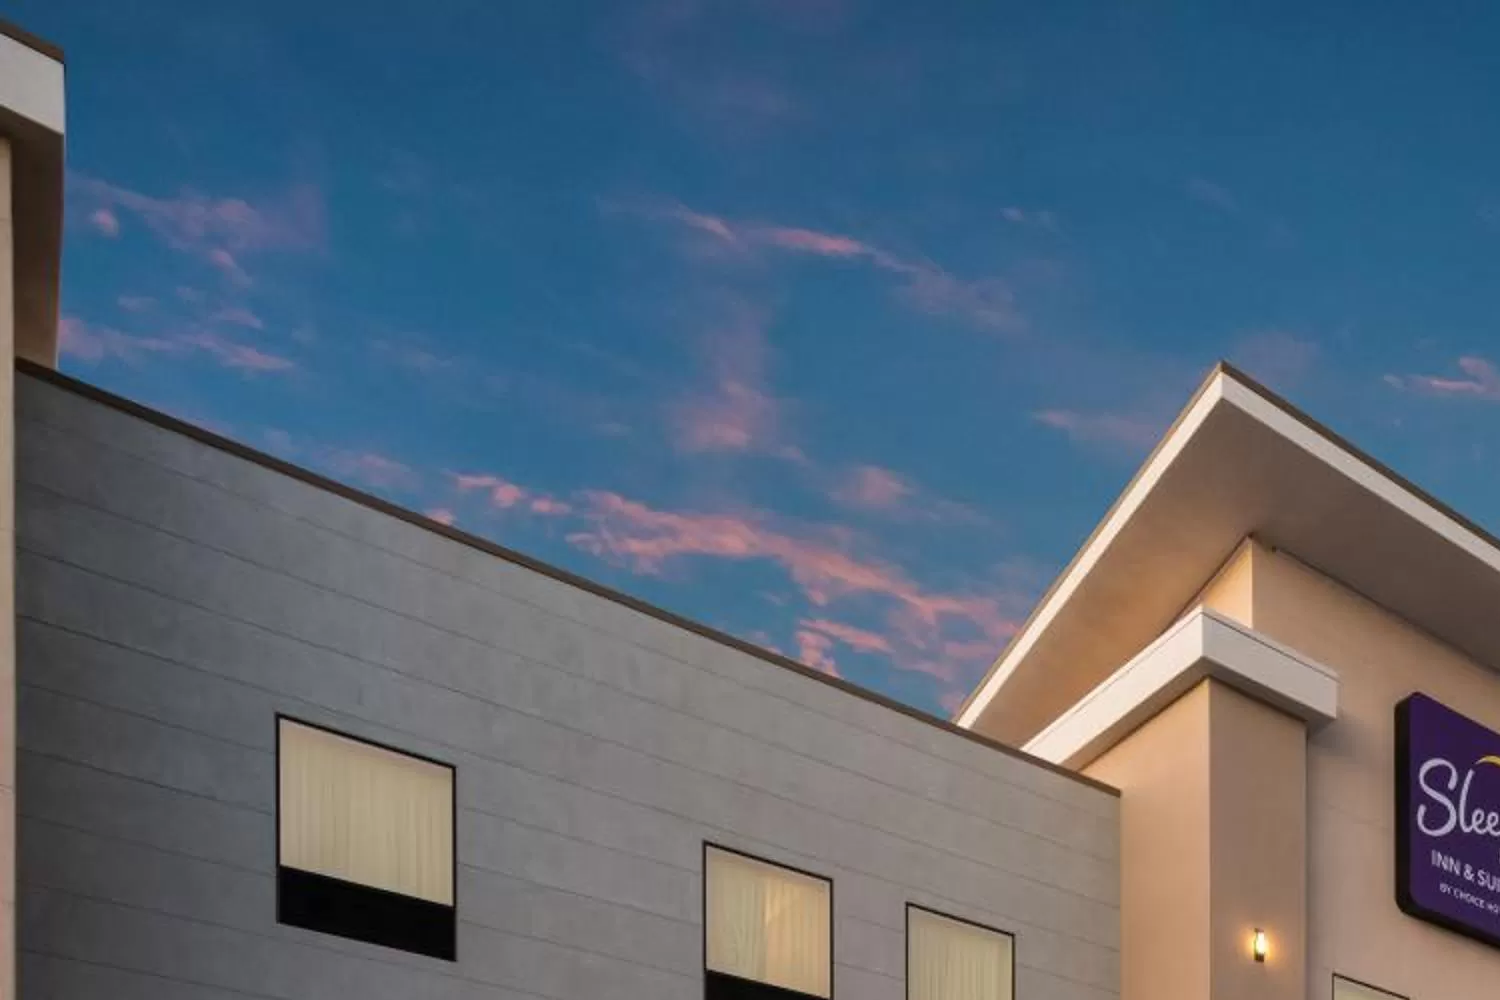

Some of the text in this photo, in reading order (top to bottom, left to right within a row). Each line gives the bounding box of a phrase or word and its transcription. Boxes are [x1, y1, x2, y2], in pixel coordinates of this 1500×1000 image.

[1431, 849, 1461, 876] INN
[1463, 863, 1475, 882] &
[1453, 888, 1485, 909] CHOICE
